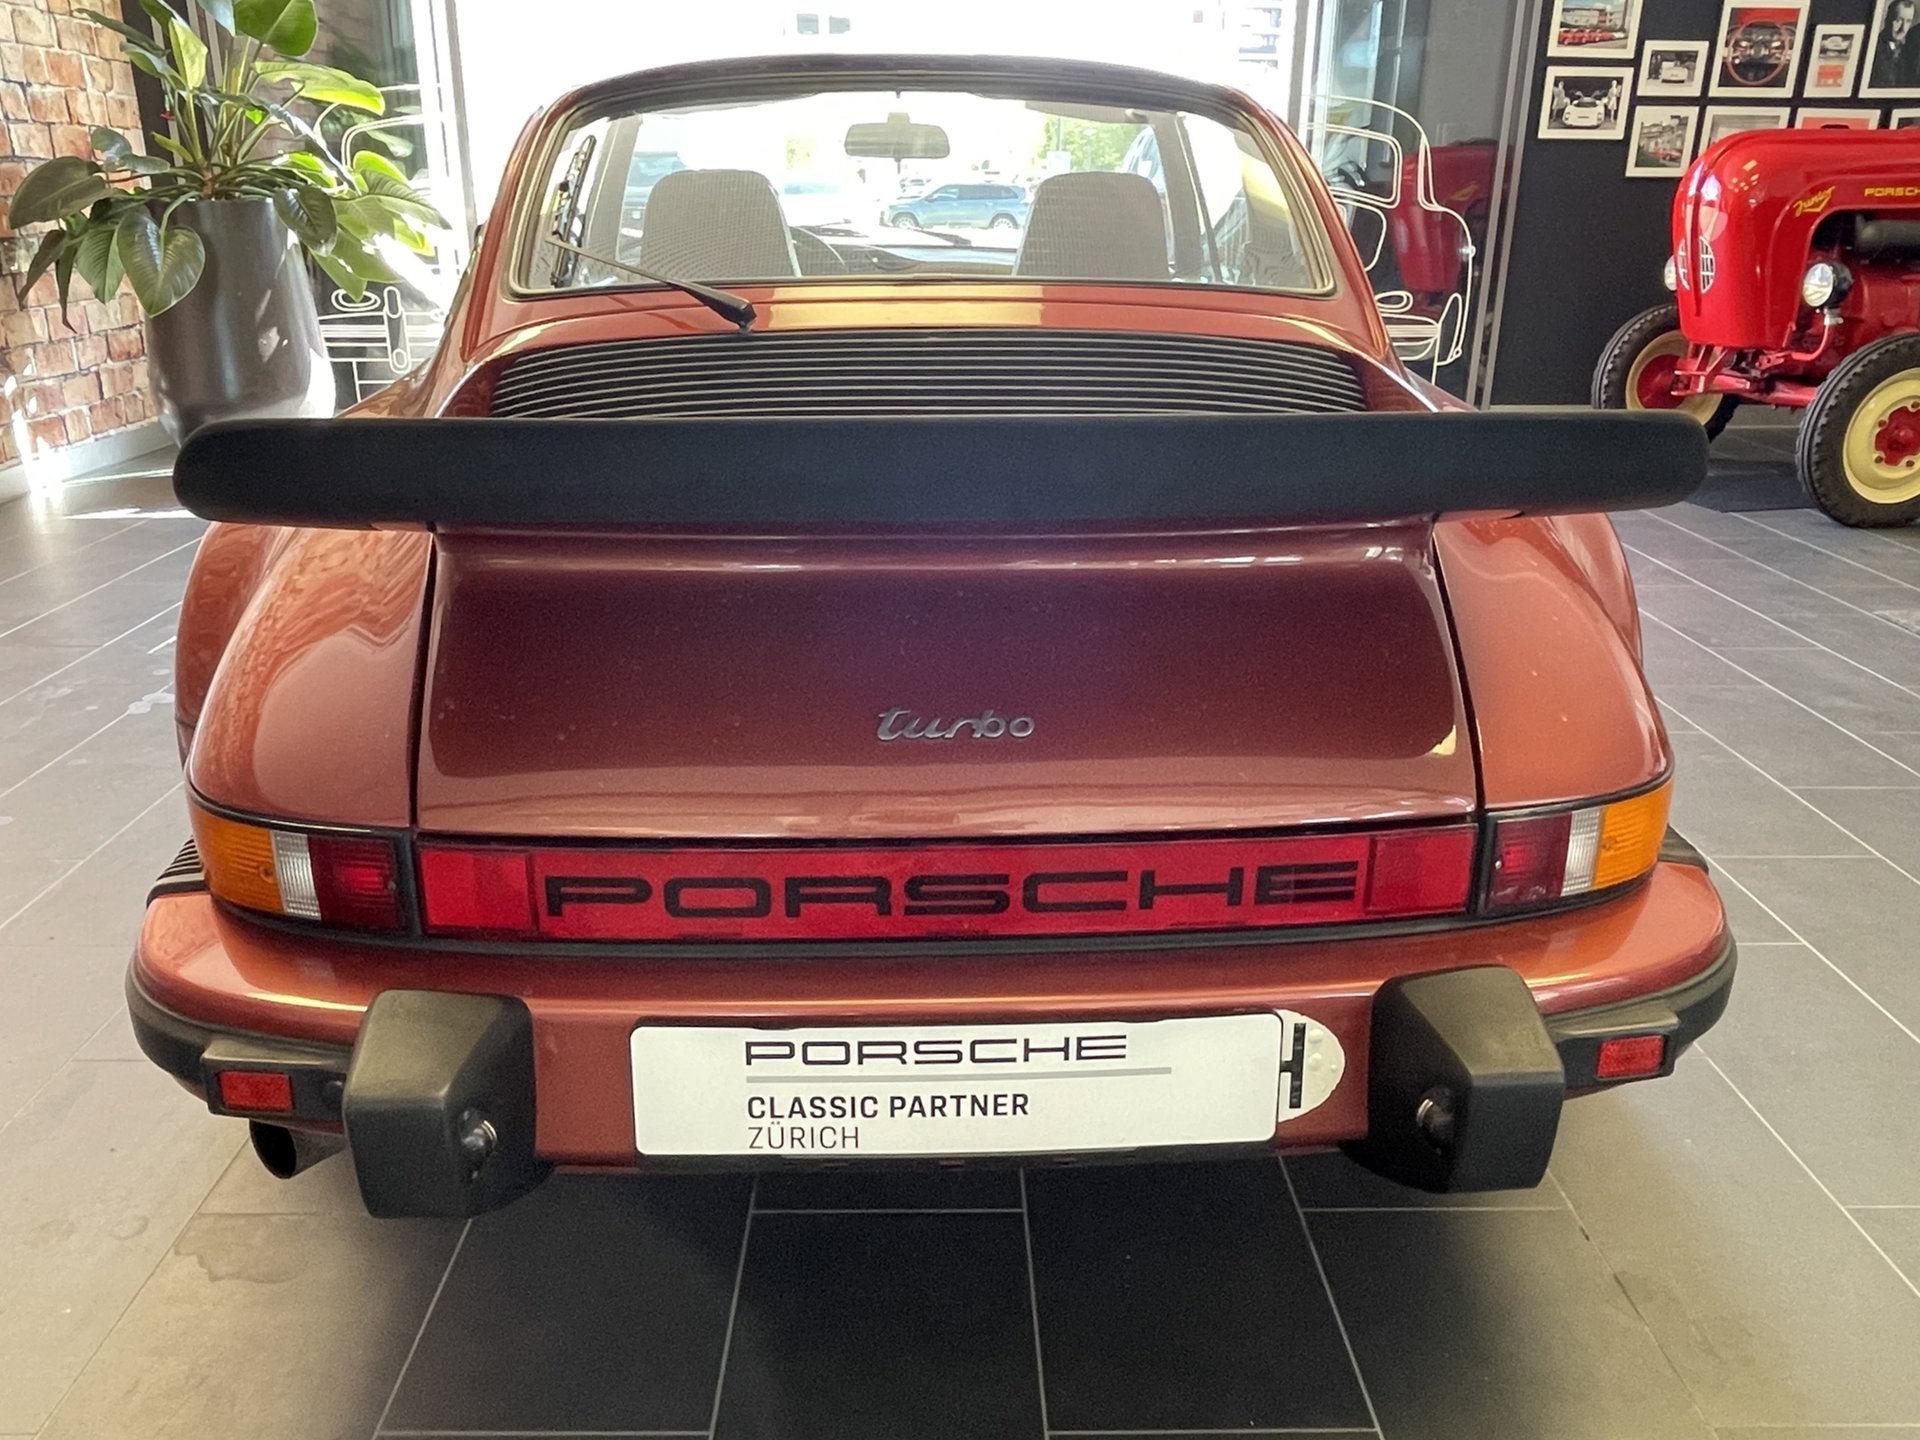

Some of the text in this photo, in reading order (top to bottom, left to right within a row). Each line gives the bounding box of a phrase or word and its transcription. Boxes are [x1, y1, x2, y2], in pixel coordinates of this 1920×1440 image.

[877, 707, 1035, 741] turbo
[545, 861, 1359, 918] PORSCHE
[745, 1035, 1127, 1066] PORSCHE
[747, 1093, 1030, 1119] CLASSIC PARTNER
[748, 1122, 860, 1149] ZÜRICH
